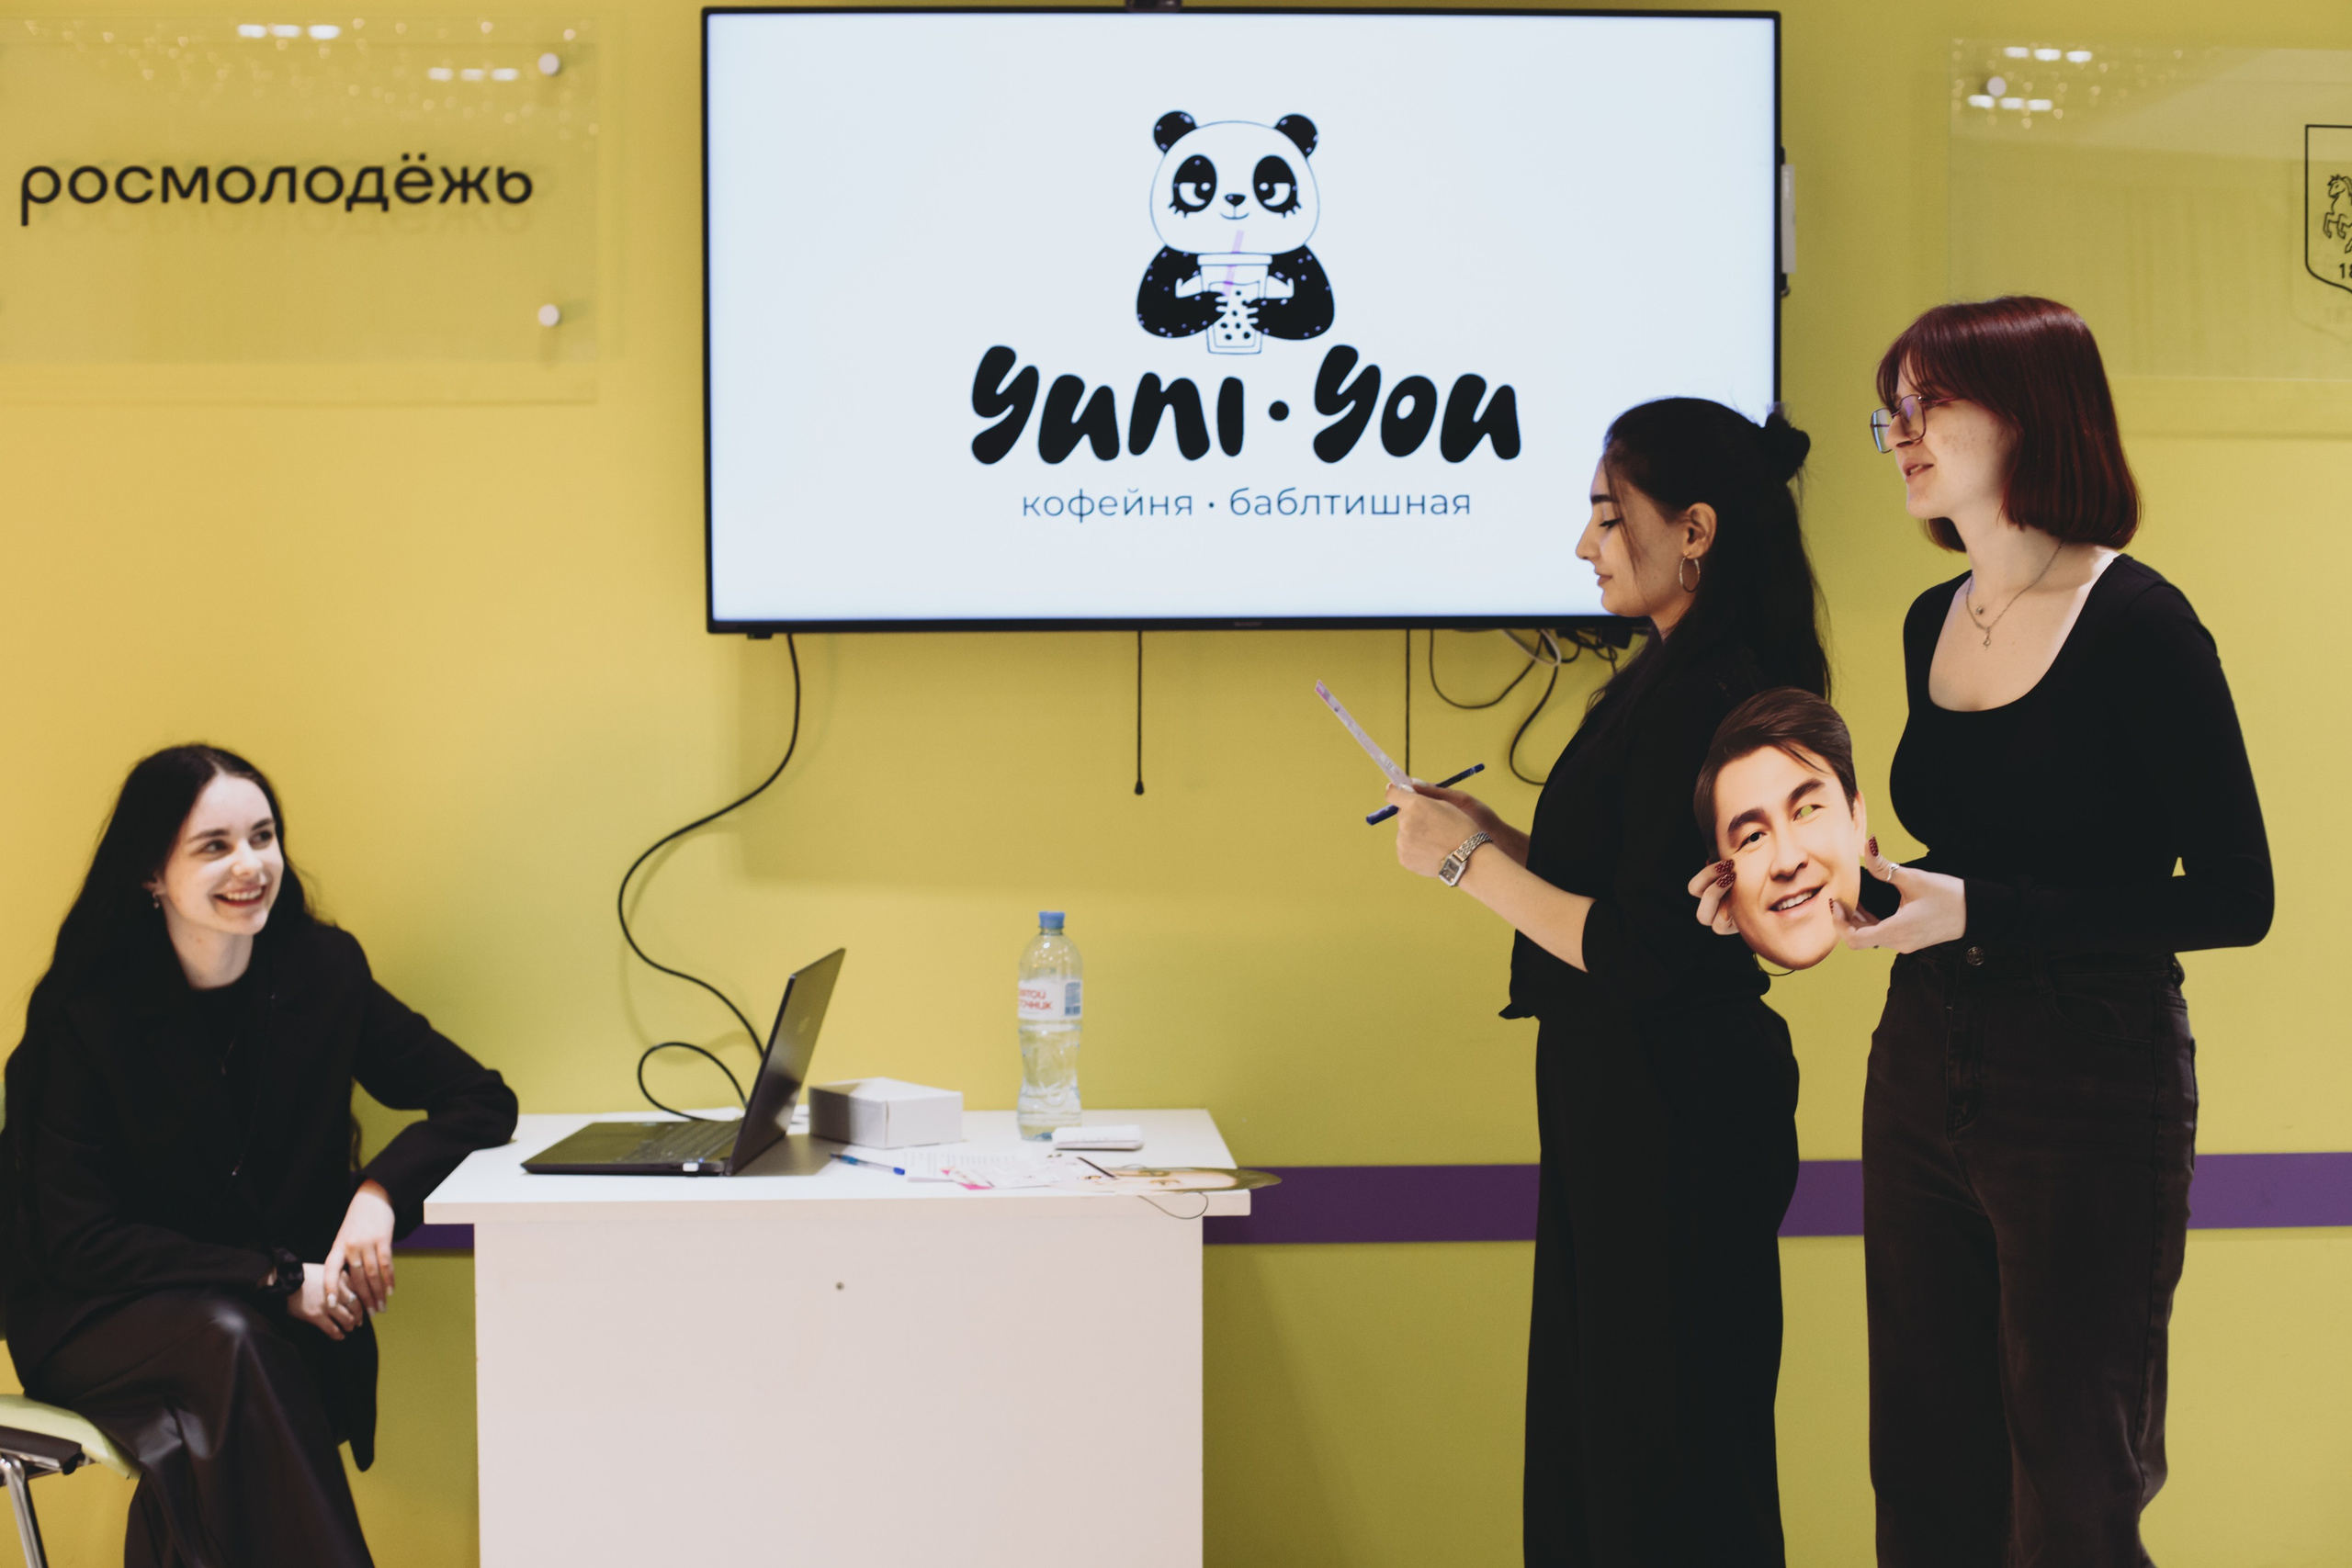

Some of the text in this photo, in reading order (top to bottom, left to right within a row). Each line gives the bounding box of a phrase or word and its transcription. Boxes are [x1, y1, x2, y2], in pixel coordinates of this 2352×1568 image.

[21, 152, 533, 227] росмолодёжь
[1023, 486, 1470, 524] кофейня баблтишная
